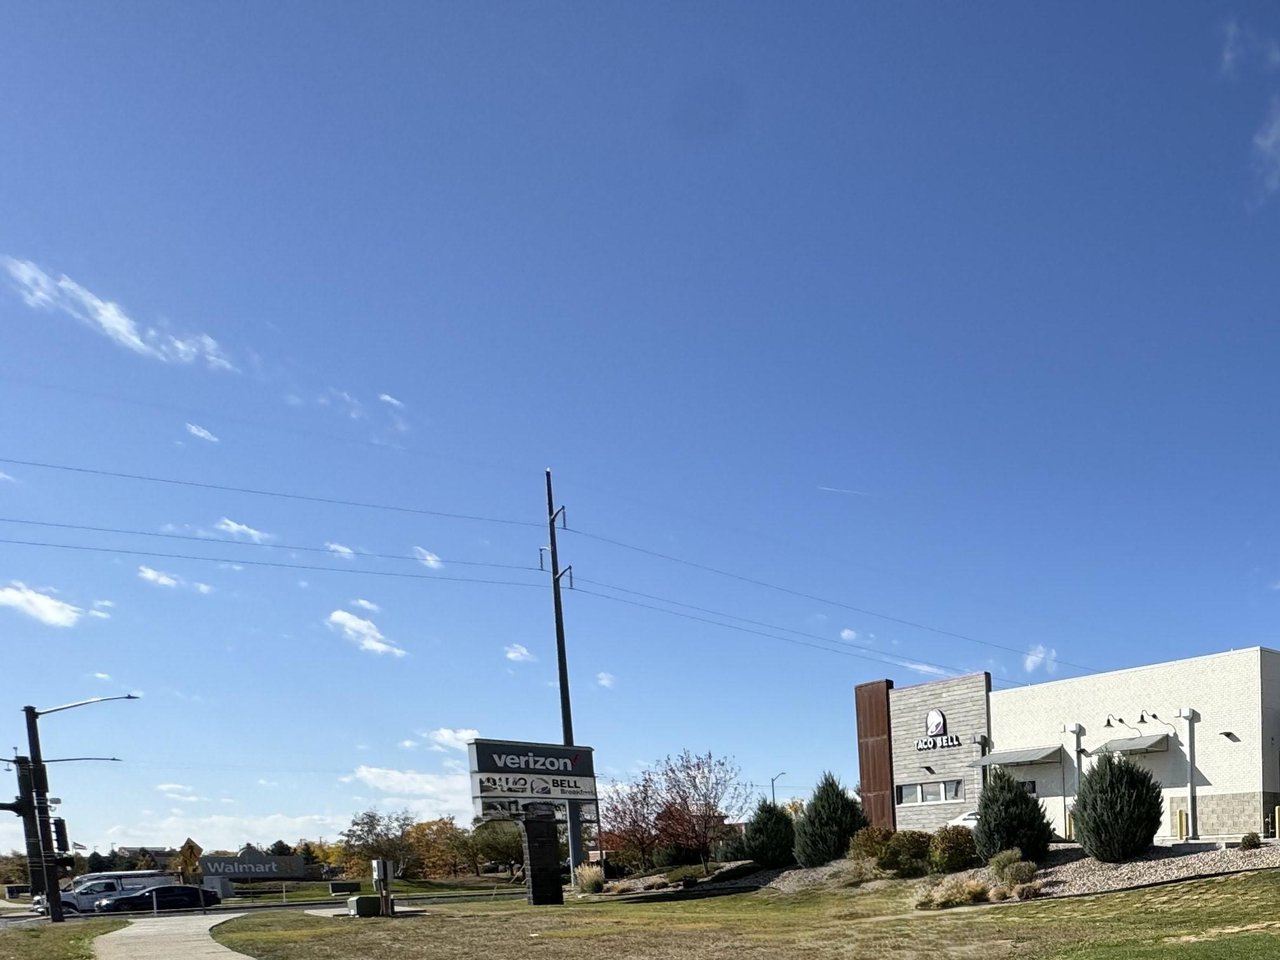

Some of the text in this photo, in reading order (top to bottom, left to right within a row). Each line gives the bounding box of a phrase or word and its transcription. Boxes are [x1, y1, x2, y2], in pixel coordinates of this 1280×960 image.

[914, 735, 959, 750] TACO BELL
[493, 752, 572, 771] verizon
[552, 779, 581, 789] BELL
[207, 861, 278, 873] Walmart
